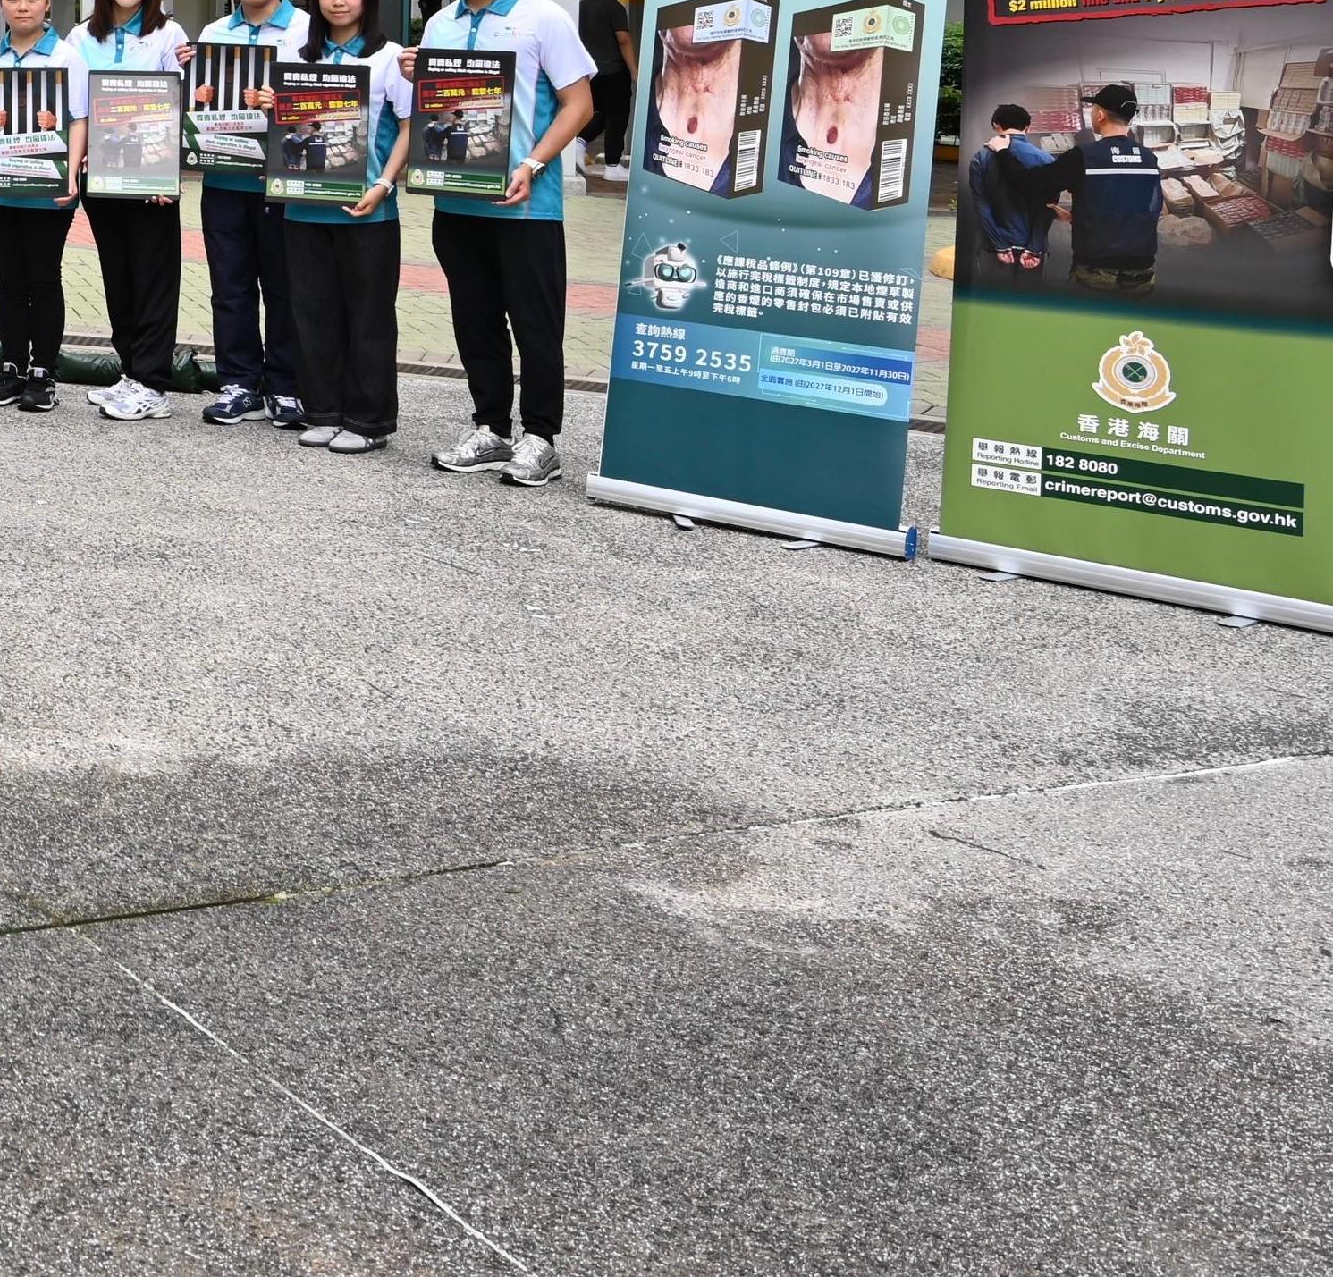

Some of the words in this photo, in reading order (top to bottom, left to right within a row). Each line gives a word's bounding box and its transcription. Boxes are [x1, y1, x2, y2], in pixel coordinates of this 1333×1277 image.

[796, 144, 823, 159] Smoking
[824, 151, 848, 163] causes
[635, 322, 686, 340] 查詢熱線
[632, 340, 687, 363] 3759
[695, 348, 751, 372] 2535
[1077, 413, 1189, 447] 香港海關
[1059, 432, 1100, 444] Customs
[1101, 436, 1119, 448] and
[1120, 439, 1149, 451] Excise
[1151, 443, 1206, 460] Department
[1046, 454, 1075, 469] 182
[1078, 458, 1118, 474] 8080
[1044, 479, 1298, 529] crimereport@customs.gov.hk
